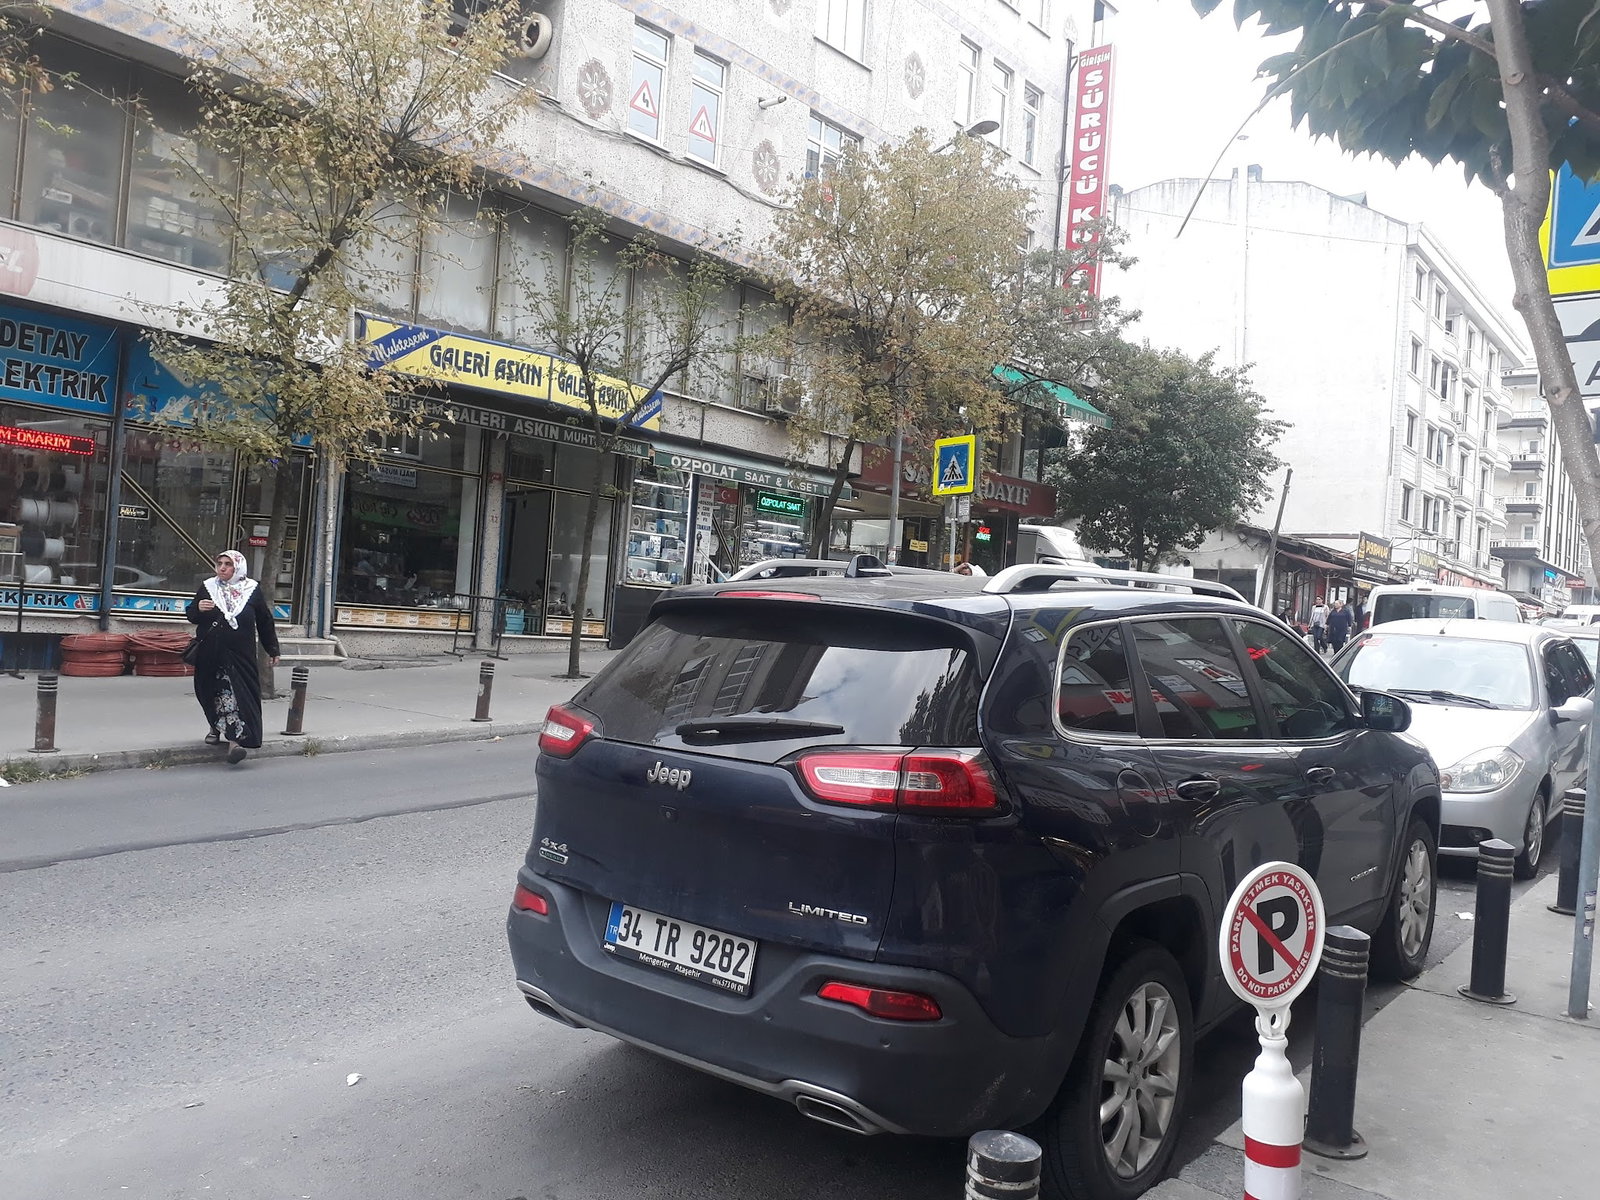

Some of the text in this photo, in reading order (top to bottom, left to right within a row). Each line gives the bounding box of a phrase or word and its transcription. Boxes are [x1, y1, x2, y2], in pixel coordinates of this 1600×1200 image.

[1074, 69, 1104, 195] SÜRÜCÜ
[430, 345, 543, 387] GALERİ AŞKIN
[744, 471, 771, 484] SAAT
[775, 477, 783, 488] &
[787, 480, 819, 494] KSET
[786, 501, 801, 511] SAAT
[647, 760, 691, 791] Jeep
[788, 901, 868, 925] LIMITED
[1232, 874, 1314, 952] PARK ETMEK YASAKTIR
[618, 910, 643, 946] 34
[654, 918, 681, 957] TR
[690, 930, 750, 979] 9282
[1237, 951, 1311, 995] DO NOT PARK HERE
